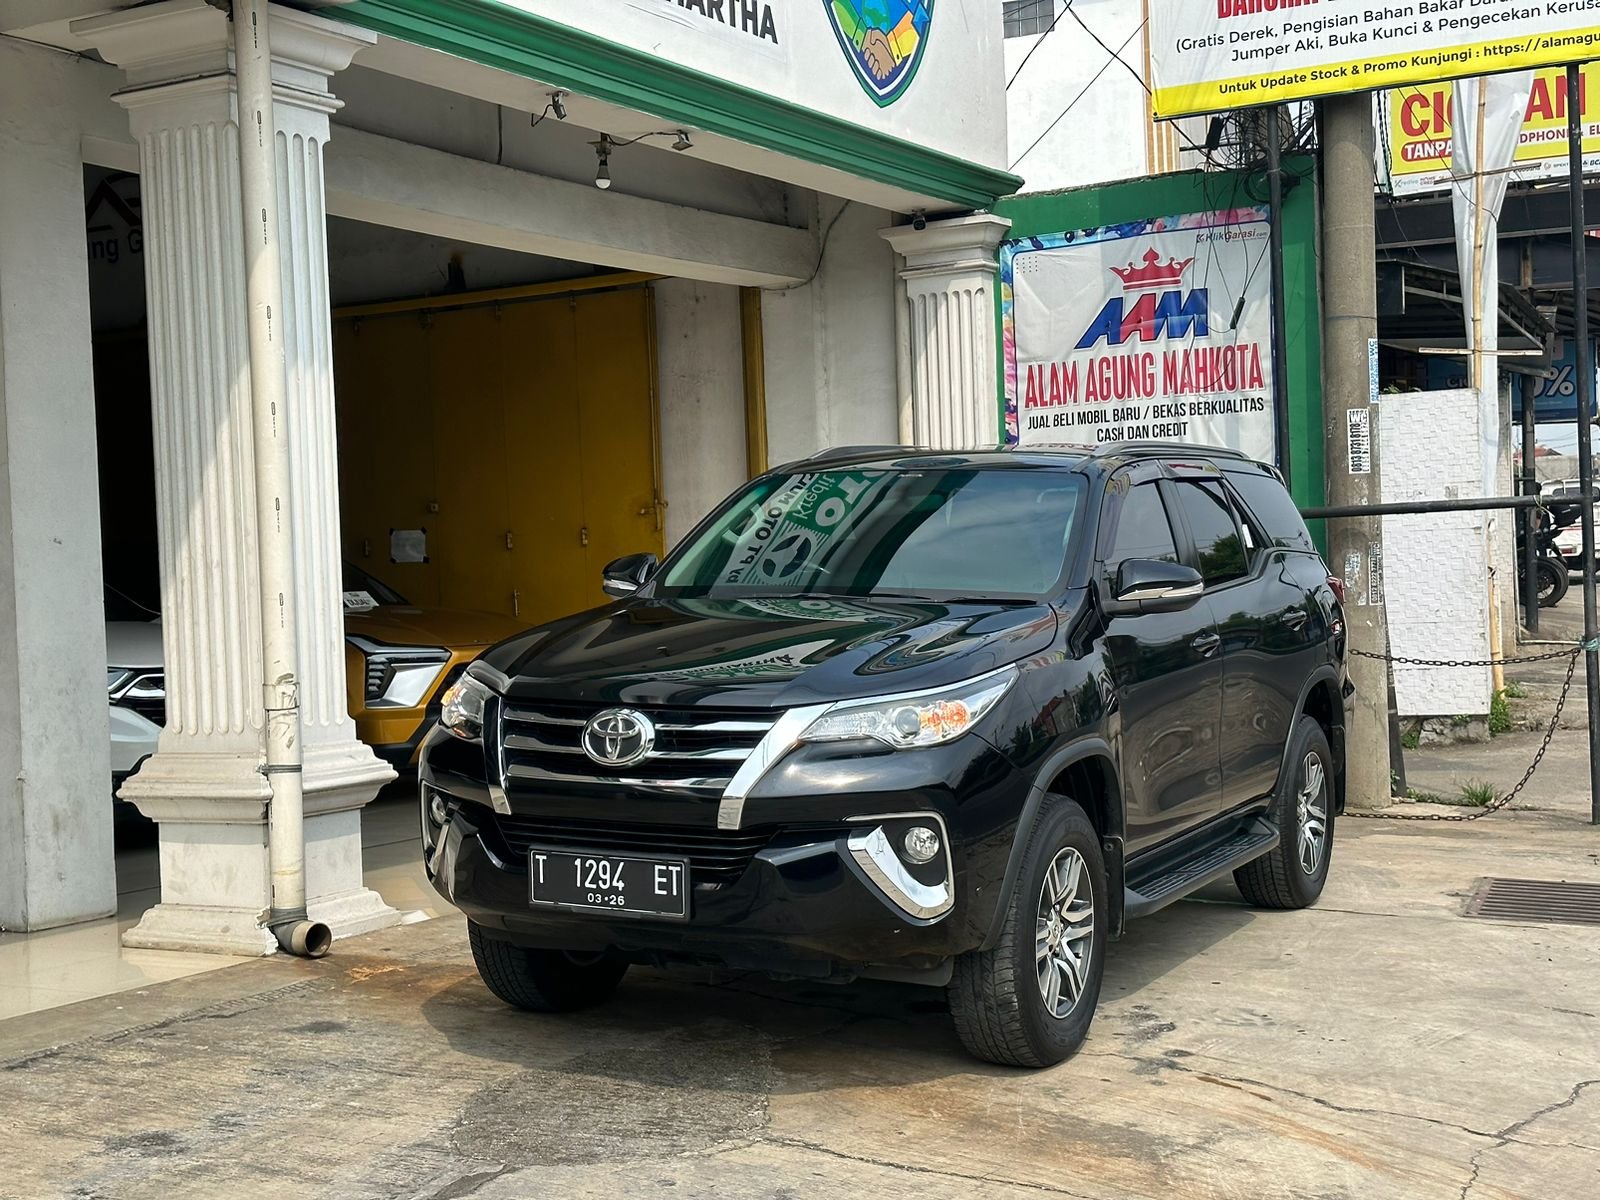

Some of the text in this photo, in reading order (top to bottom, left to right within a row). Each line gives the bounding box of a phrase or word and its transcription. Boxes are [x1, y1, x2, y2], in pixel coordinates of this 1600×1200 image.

[1176, 0, 1462, 53] (Gratis Derek, Pengisian Bahan Bakar
[1232, 42, 1290, 61] Jumper
[1295, 36, 1323, 53] Aki,
[1329, 31, 1367, 47] Buka
[1373, 22, 1417, 39] Kunci
[1422, 20, 1433, 33] &
[1439, 7, 1540, 30] Pengecekan
[1219, 80, 1256, 95] Untuk
[1261, 73, 1306, 90] Update
[1311, 66, 1347, 81] Stock
[1351, 64, 1360, 75] &
[1364, 59, 1407, 74] Promo
[1412, 48, 1472, 66] Kunjungi
[1074, 288, 1209, 349] AAM
[1025, 343, 1265, 409] ALAM AGUNG MAHKOTA
[1028, 412, 1050, 430] JUAL
[1053, 410, 1075, 428] BELI
[1077, 408, 1110, 425] MOBIL
[1113, 405, 1141, 422] BARU
[1153, 401, 1186, 419] BEKAS
[1189, 397, 1264, 416] BERKUALITAS
[1097, 421, 1188, 443] CASH DAN CREDIT
[535, 855, 681, 896] T 1294 ET
